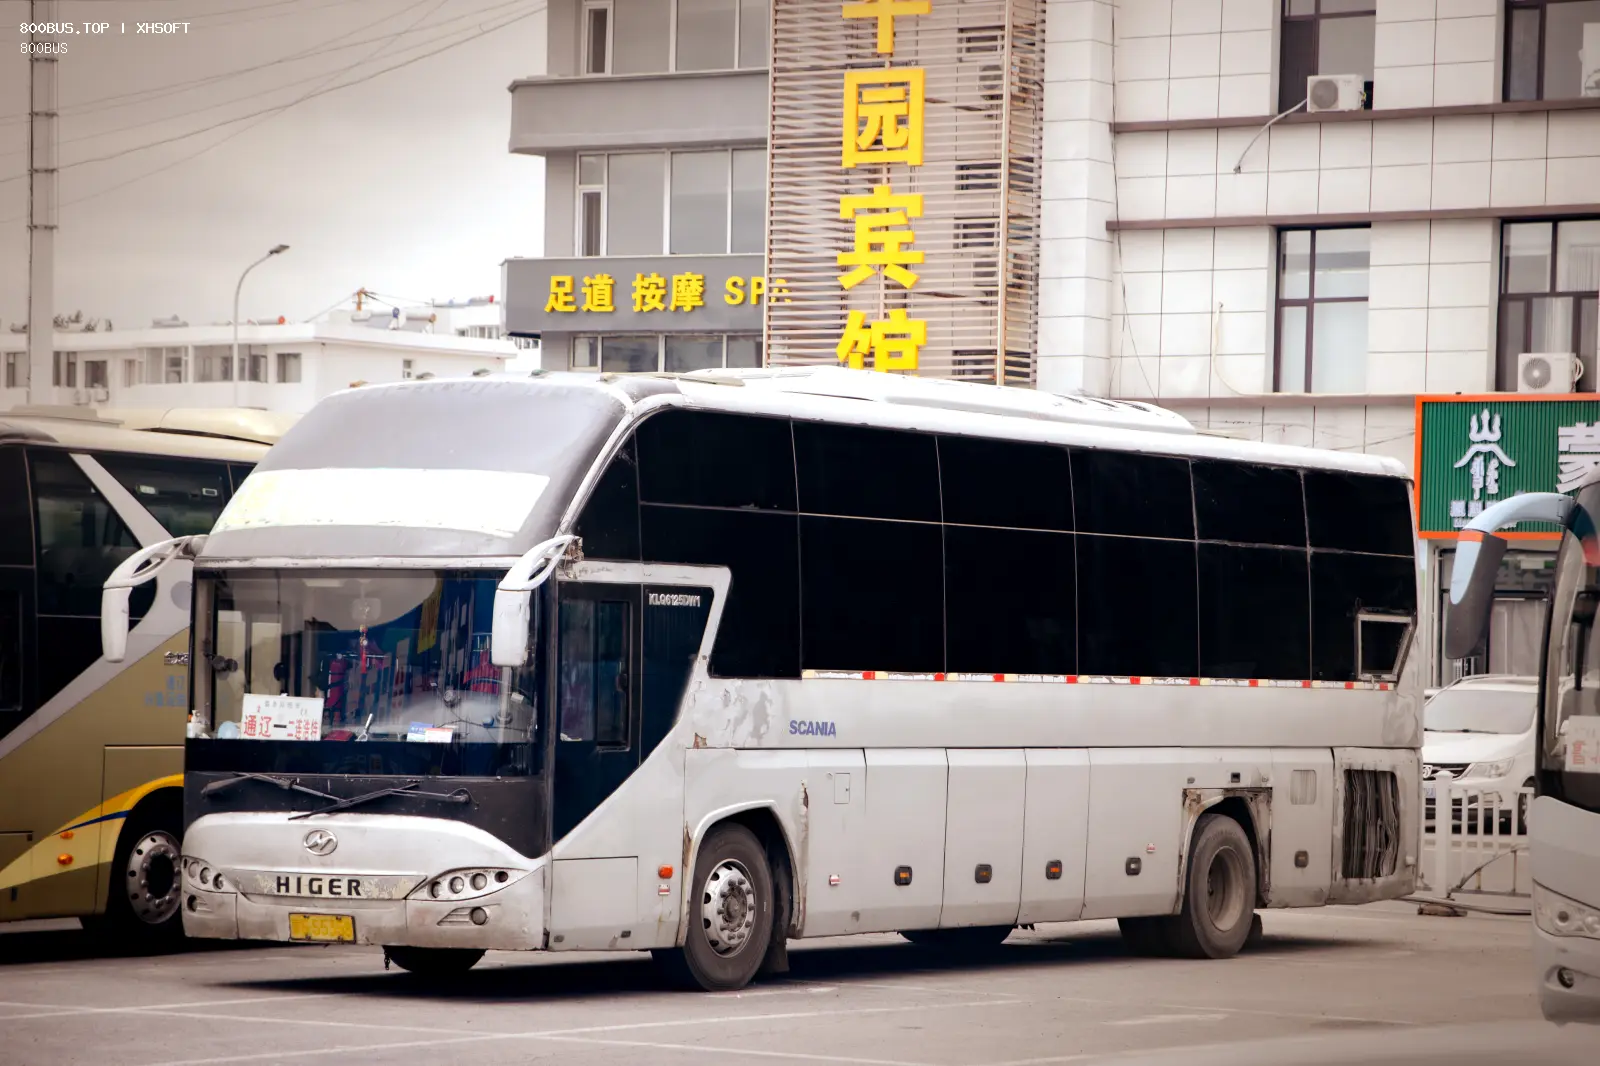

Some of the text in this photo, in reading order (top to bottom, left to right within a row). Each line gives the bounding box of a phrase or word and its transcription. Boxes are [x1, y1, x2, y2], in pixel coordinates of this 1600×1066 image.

[544, 274, 616, 313] 足道
[631, 272, 706, 313] 按摩
[788, 719, 837, 738] SCANIA
[276, 875, 362, 897] HIGER
